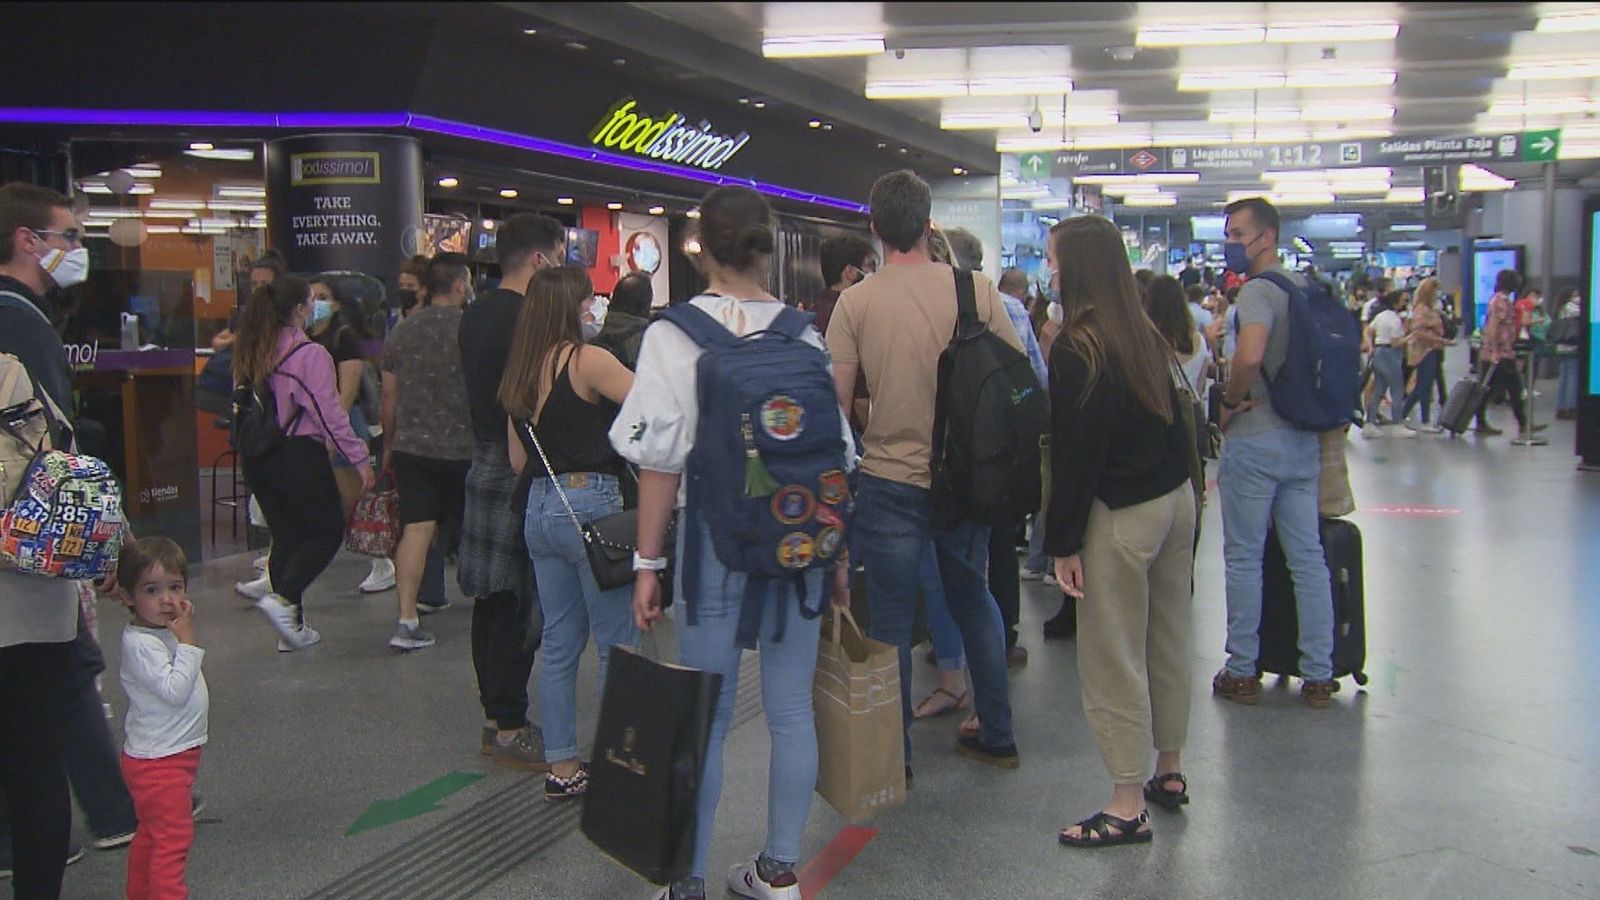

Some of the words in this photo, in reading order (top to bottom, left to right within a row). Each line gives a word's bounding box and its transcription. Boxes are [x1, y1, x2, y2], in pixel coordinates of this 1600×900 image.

[592, 100, 750, 169] foodissimo!
[1380, 141, 1421, 153] Salidas
[1424, 140, 1462, 150] Planta
[1466, 138, 1493, 150] Baja
[1057, 152, 1089, 166] renfe
[1192, 148, 1239, 162] Llegadas
[313, 196, 352, 209] TAKE
[292, 214, 381, 229] EVERYTHING.
[296, 233, 328, 247] TAKE
[331, 232, 377, 245] AWAY.
